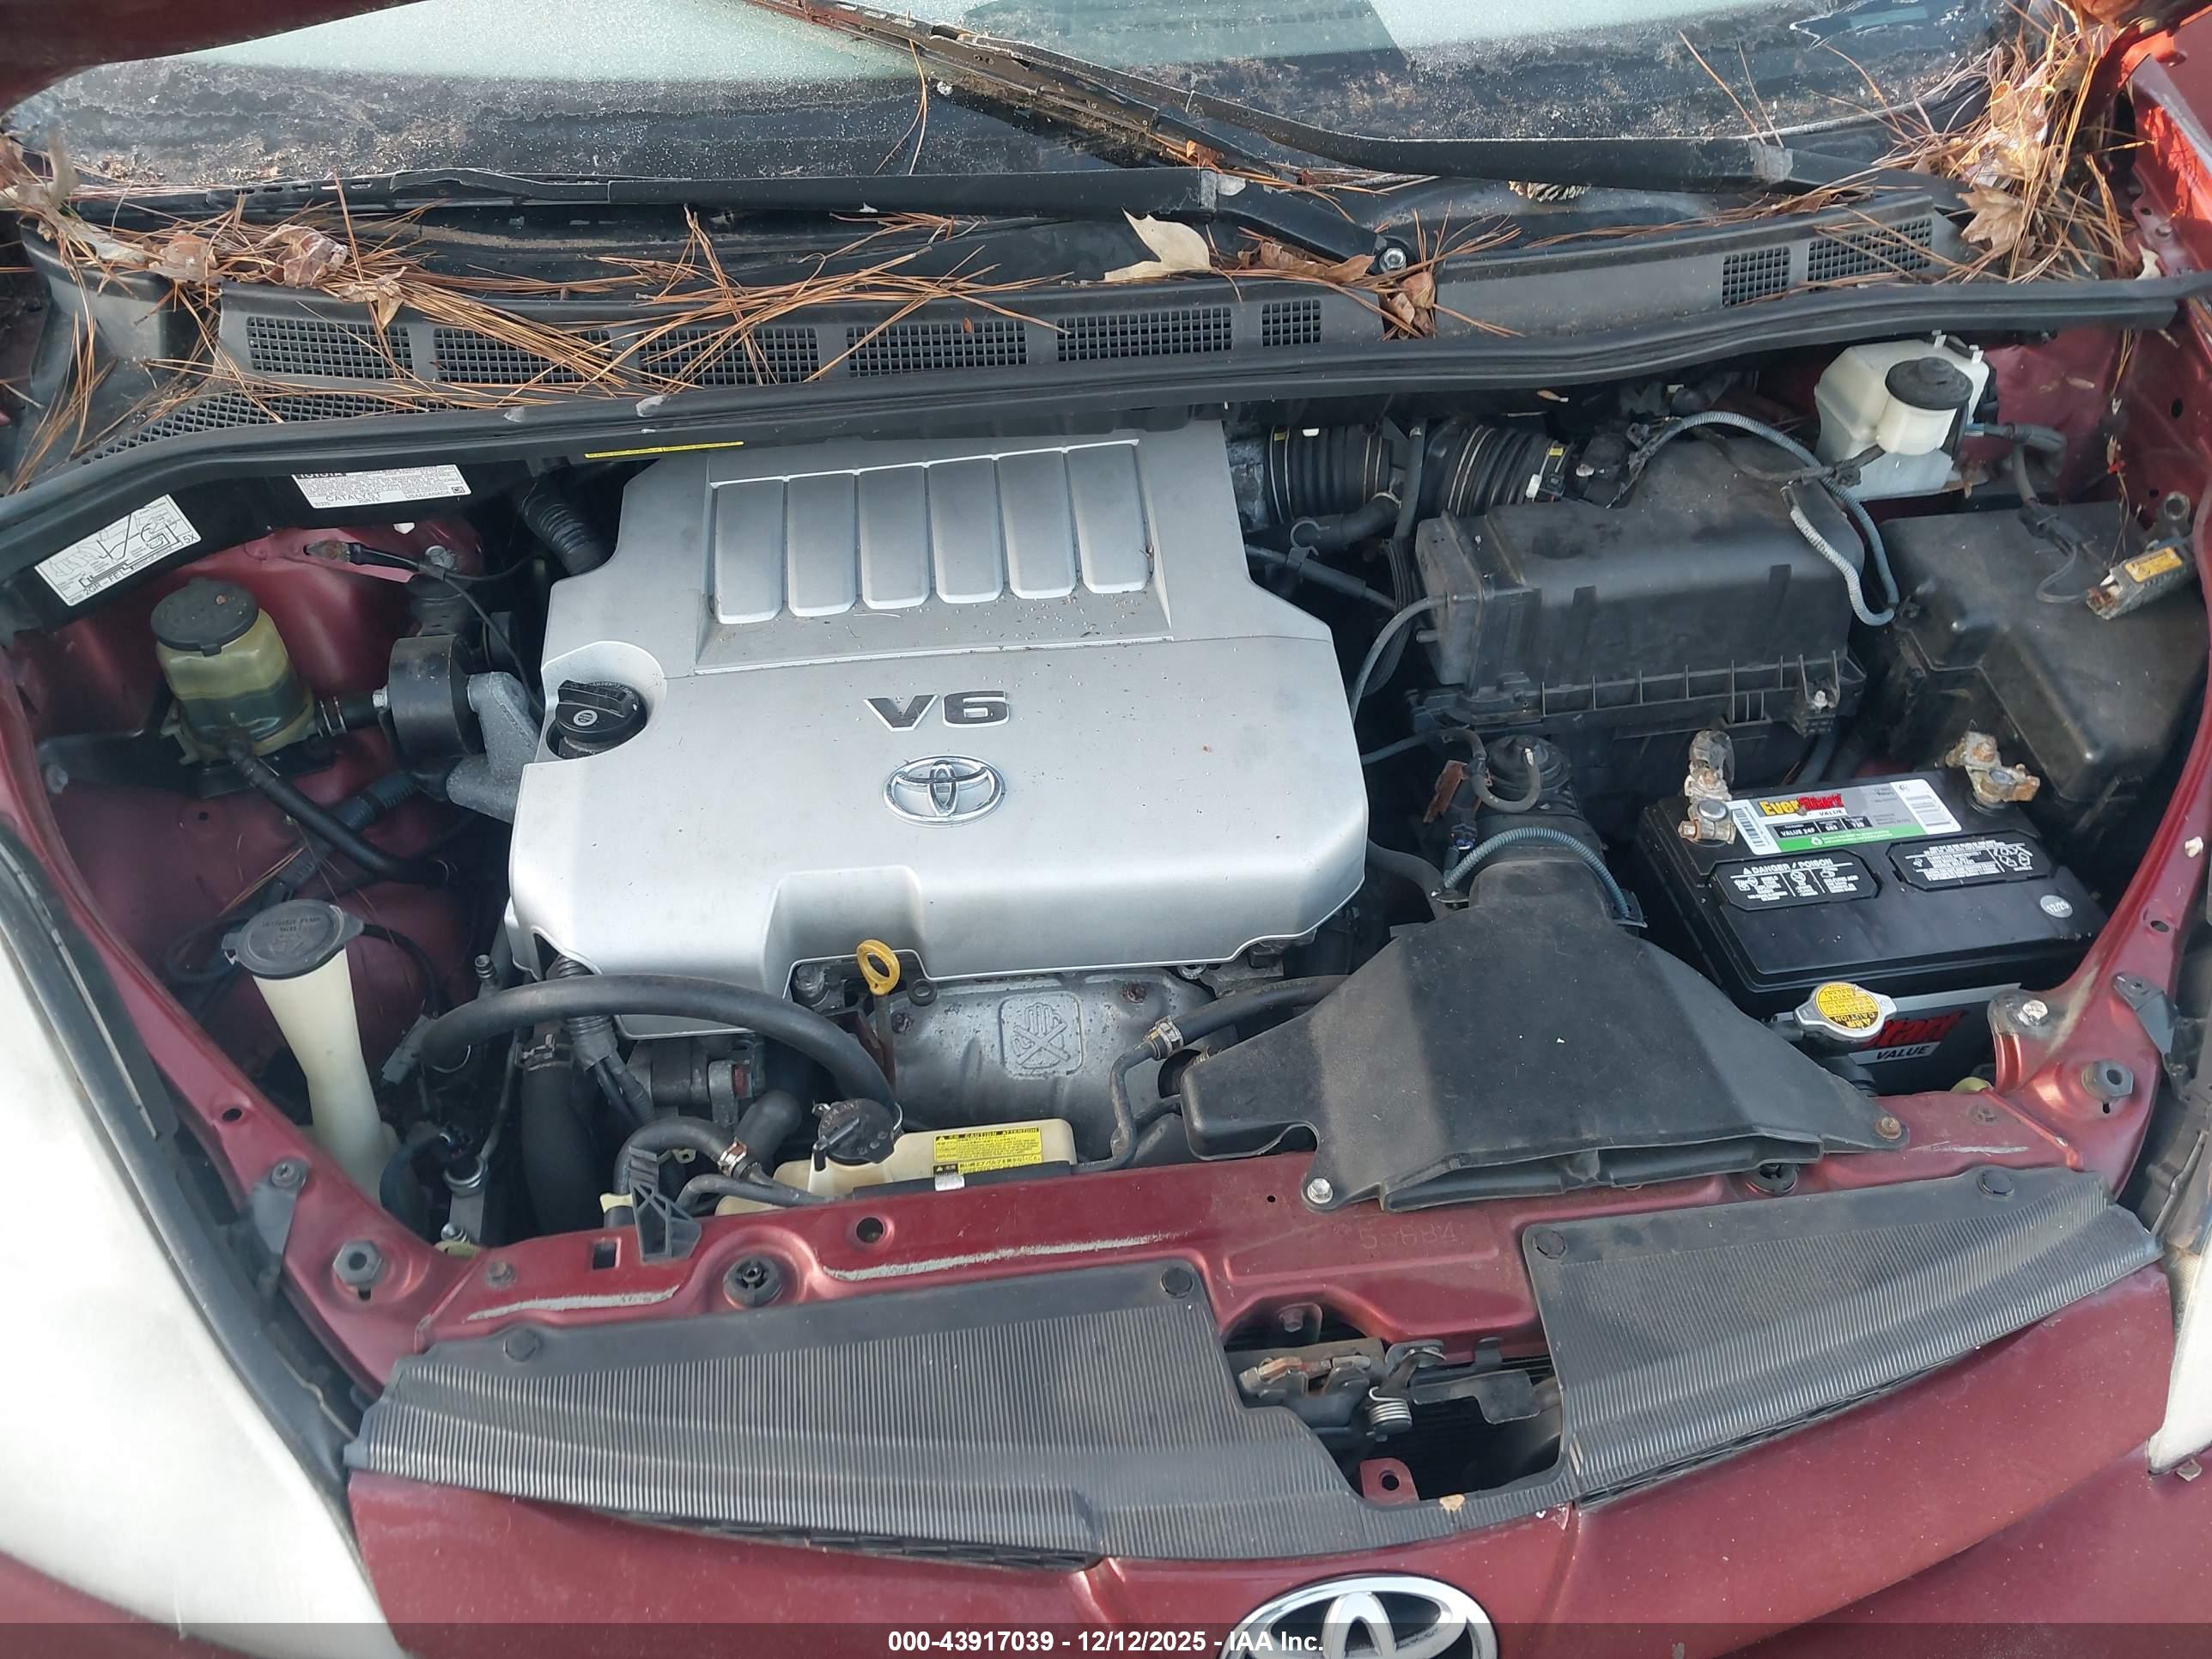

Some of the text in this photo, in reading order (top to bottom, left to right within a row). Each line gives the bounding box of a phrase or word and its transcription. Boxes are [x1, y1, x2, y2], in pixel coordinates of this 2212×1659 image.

[325, 492, 382, 502] CATALYST
[183, 532, 199, 544] 5X
[862, 690, 1011, 732] V6
[1751, 863, 1791, 874] DANGER
[1797, 858, 1834, 869] POISON
[1834, 1012, 1876, 1024] CAUTION
[1875, 1045, 1929, 1060] VALUE
